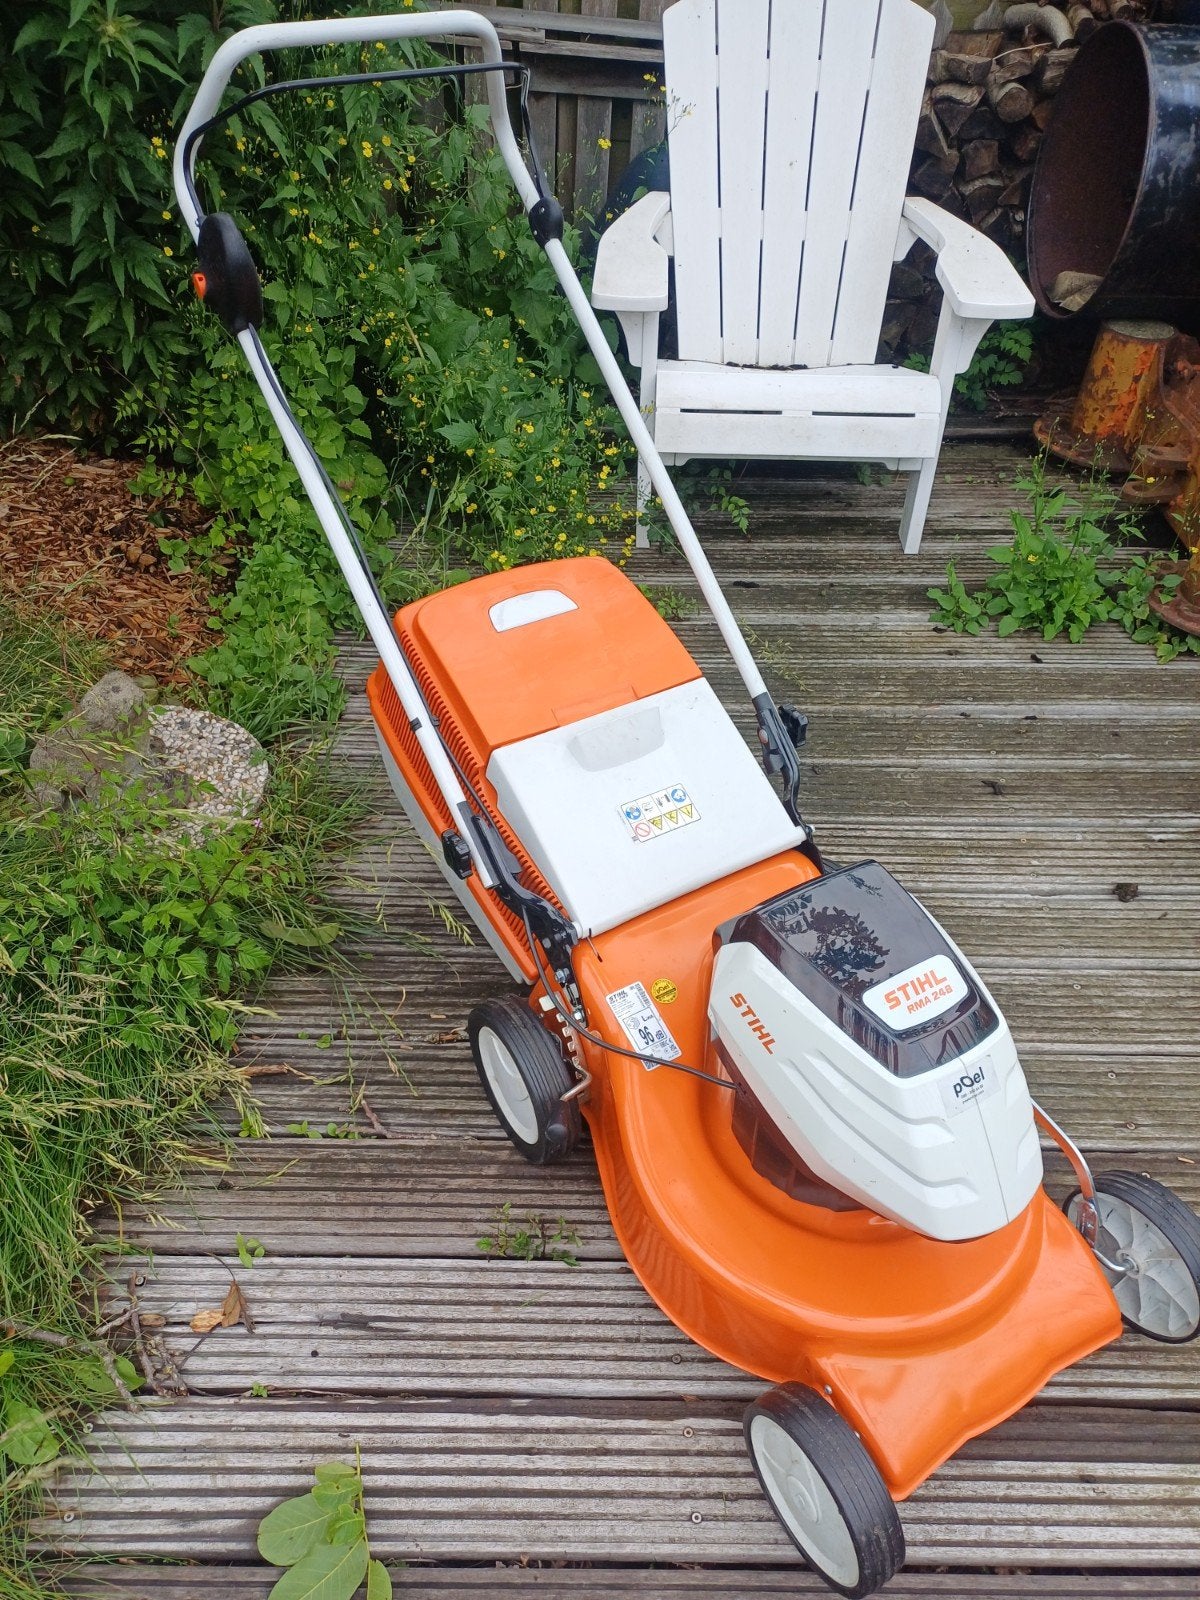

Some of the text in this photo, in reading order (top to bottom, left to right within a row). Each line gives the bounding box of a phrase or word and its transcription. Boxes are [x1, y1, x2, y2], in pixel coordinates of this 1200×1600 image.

[884, 970, 948, 1011] STIHL
[907, 984, 954, 1015] RMA 248
[638, 1025, 655, 1046] 96
[729, 992, 776, 1055] STIHL
